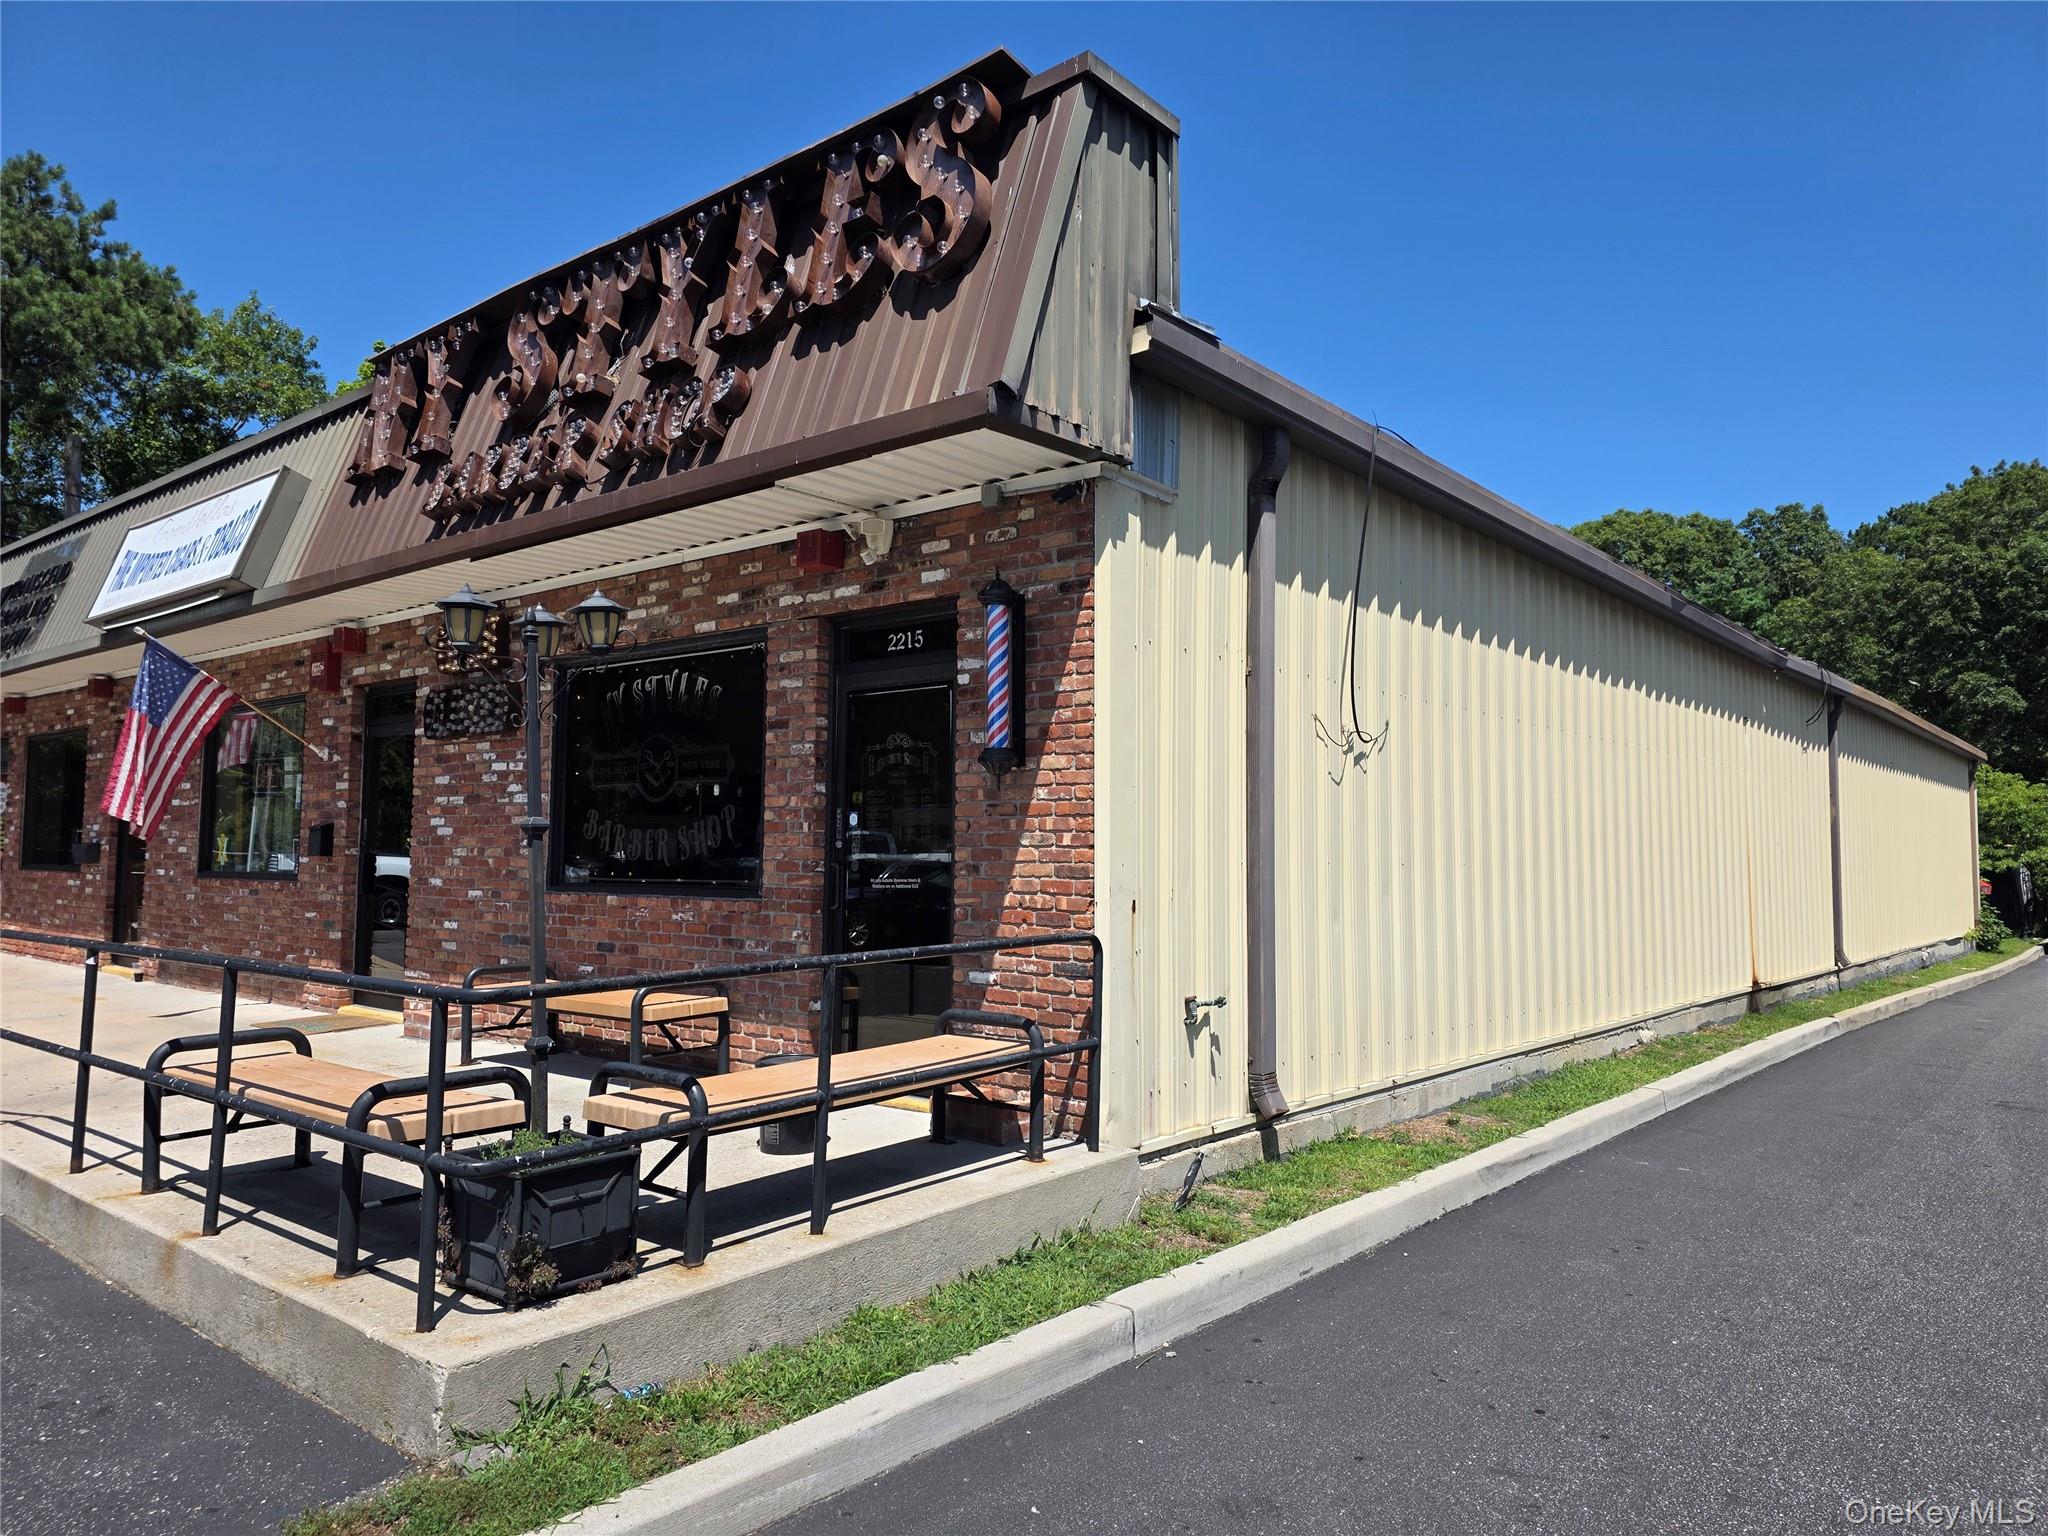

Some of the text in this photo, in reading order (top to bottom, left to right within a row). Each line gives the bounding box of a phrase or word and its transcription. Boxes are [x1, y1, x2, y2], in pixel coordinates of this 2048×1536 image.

[491, 76, 1002, 428] STYLES
[106, 549, 139, 594] FINE
[123, 549, 173, 589] IMPORTED
[164, 536, 203, 577] CIGARS
[193, 534, 213, 567] &
[203, 499, 262, 562] TOBACCO
[887, 629, 924, 652] 2215
[632, 668, 724, 720] STYLES
[583, 803, 736, 868] BARBER SHOP
